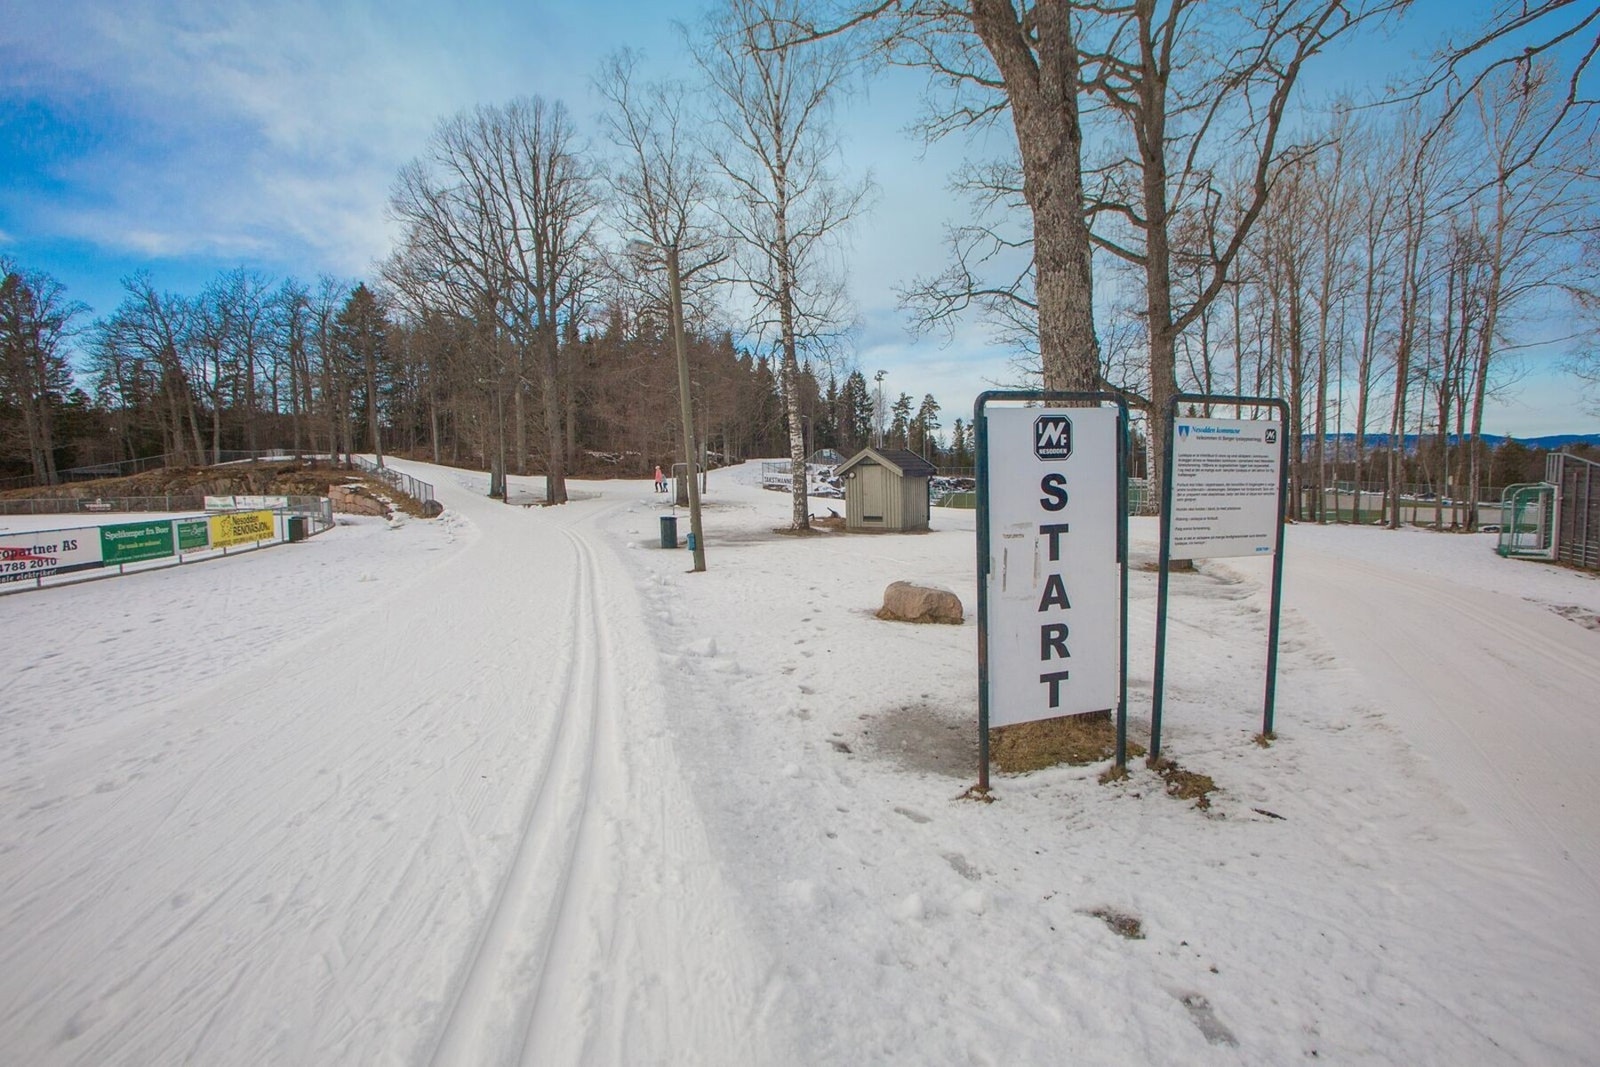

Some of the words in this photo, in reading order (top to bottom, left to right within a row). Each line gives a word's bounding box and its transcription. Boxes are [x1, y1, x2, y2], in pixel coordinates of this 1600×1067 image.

[232, 514, 259, 525] Nesodden
[233, 522, 268, 536] RENOVASJON
[62, 540, 78, 552] AS
[30, 557, 57, 569] 2010
[1039, 473, 1071, 708] START
